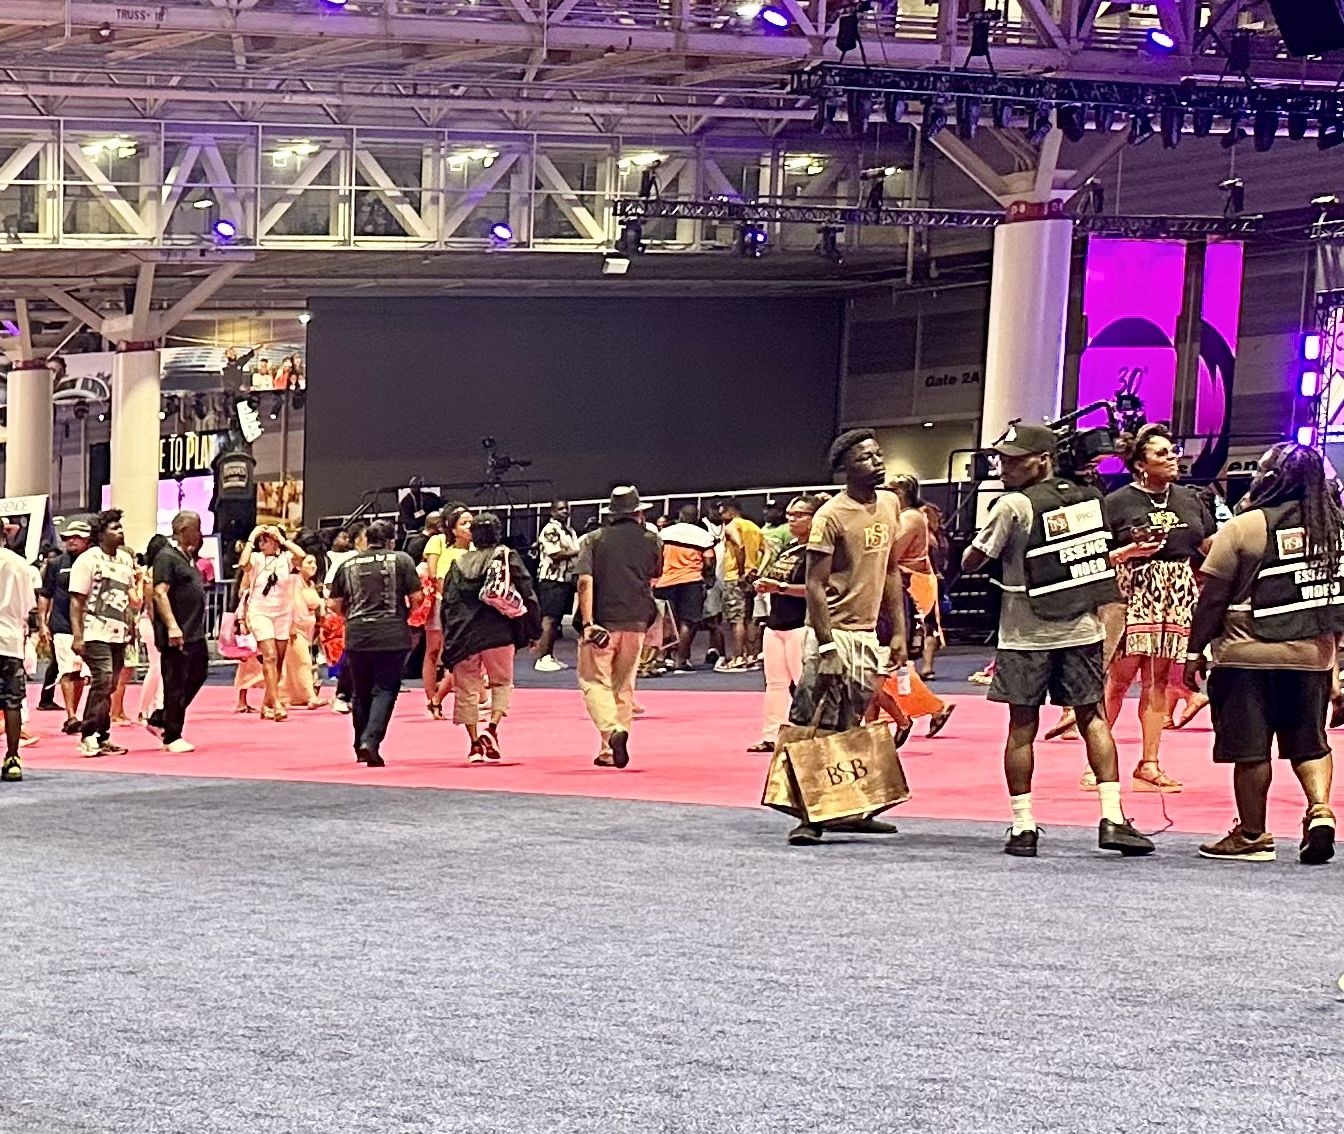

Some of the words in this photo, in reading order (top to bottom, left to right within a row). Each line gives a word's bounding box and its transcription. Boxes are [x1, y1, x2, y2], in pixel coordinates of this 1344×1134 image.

[925, 374, 958, 387] Gate
[962, 371, 980, 384] 2A
[169, 433, 183, 472] TO
[864, 522, 890, 548] BSB
[1059, 538, 1108, 564] ESSENCE
[1069, 557, 1107, 579] VIDEO
[1301, 581, 1341, 600] VIDEO
[825, 758, 869, 786] BSB
